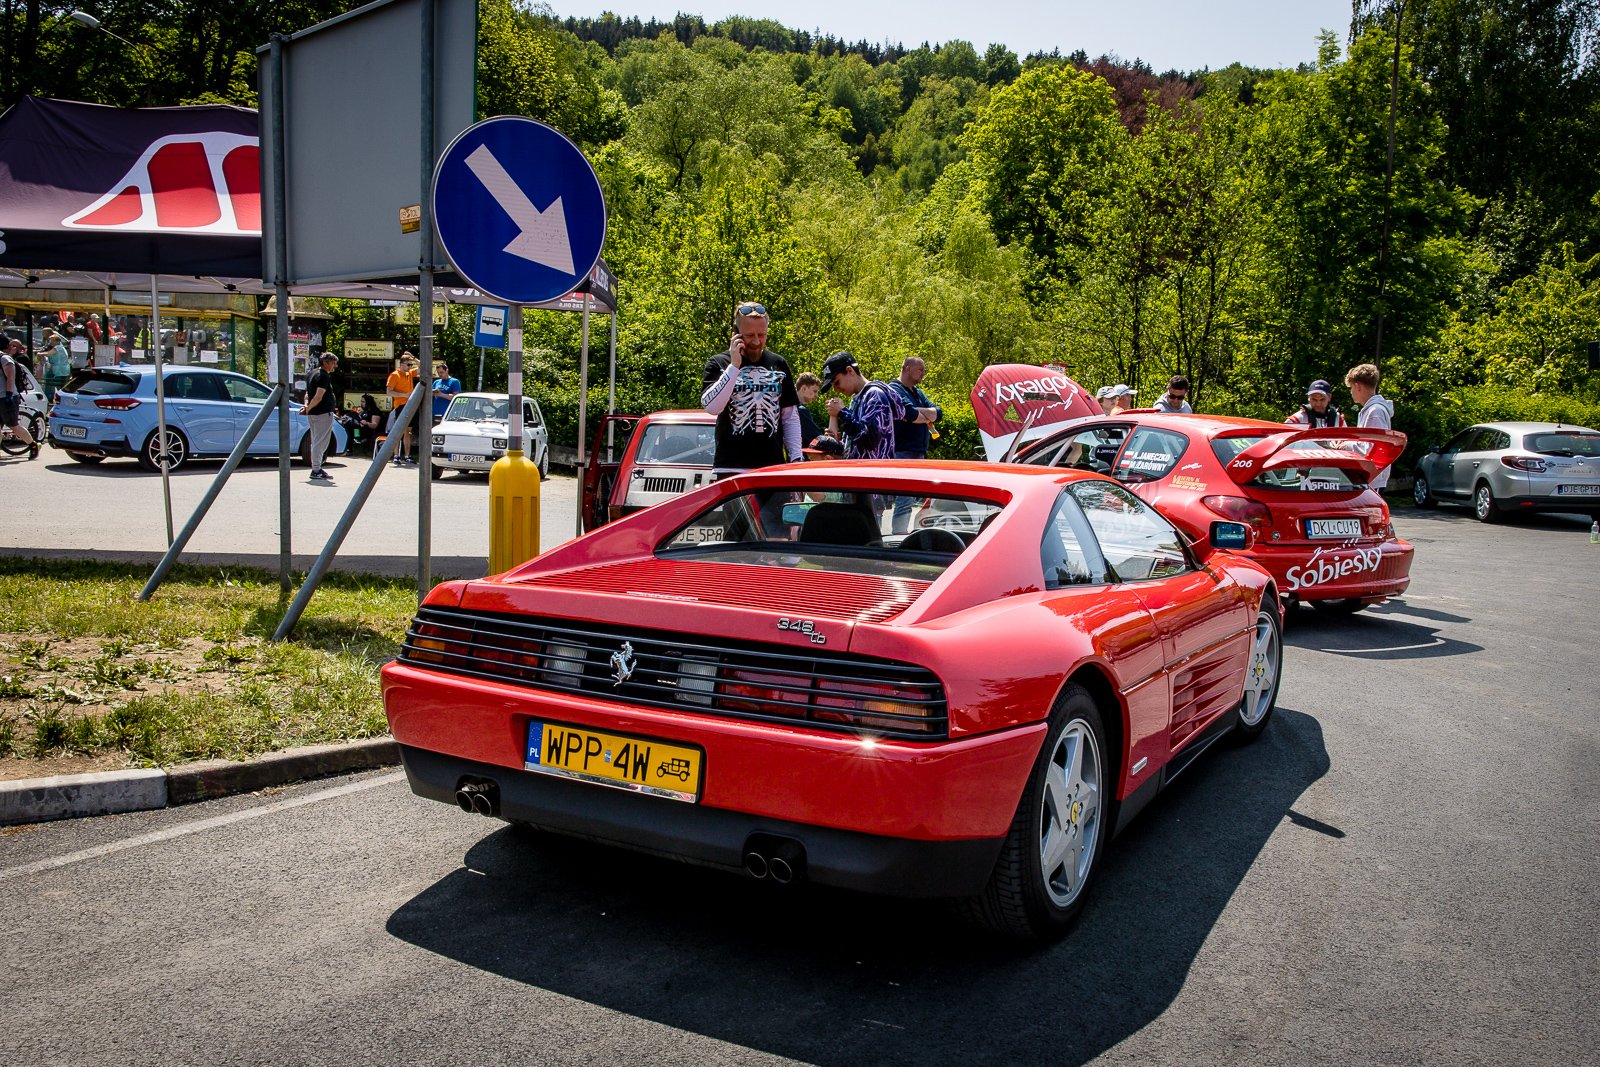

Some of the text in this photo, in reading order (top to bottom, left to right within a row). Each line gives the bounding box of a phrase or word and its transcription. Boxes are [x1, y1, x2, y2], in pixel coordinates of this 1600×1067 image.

[1232, 459, 1253, 468] 206
[699, 528, 723, 542] 5P8
[1312, 520, 1360, 535] DKL CU19
[1285, 547, 1382, 591] Sobiesky
[777, 617, 814, 632] 348
[529, 747, 540, 758] PL
[547, 729, 651, 782] WPP 4W
